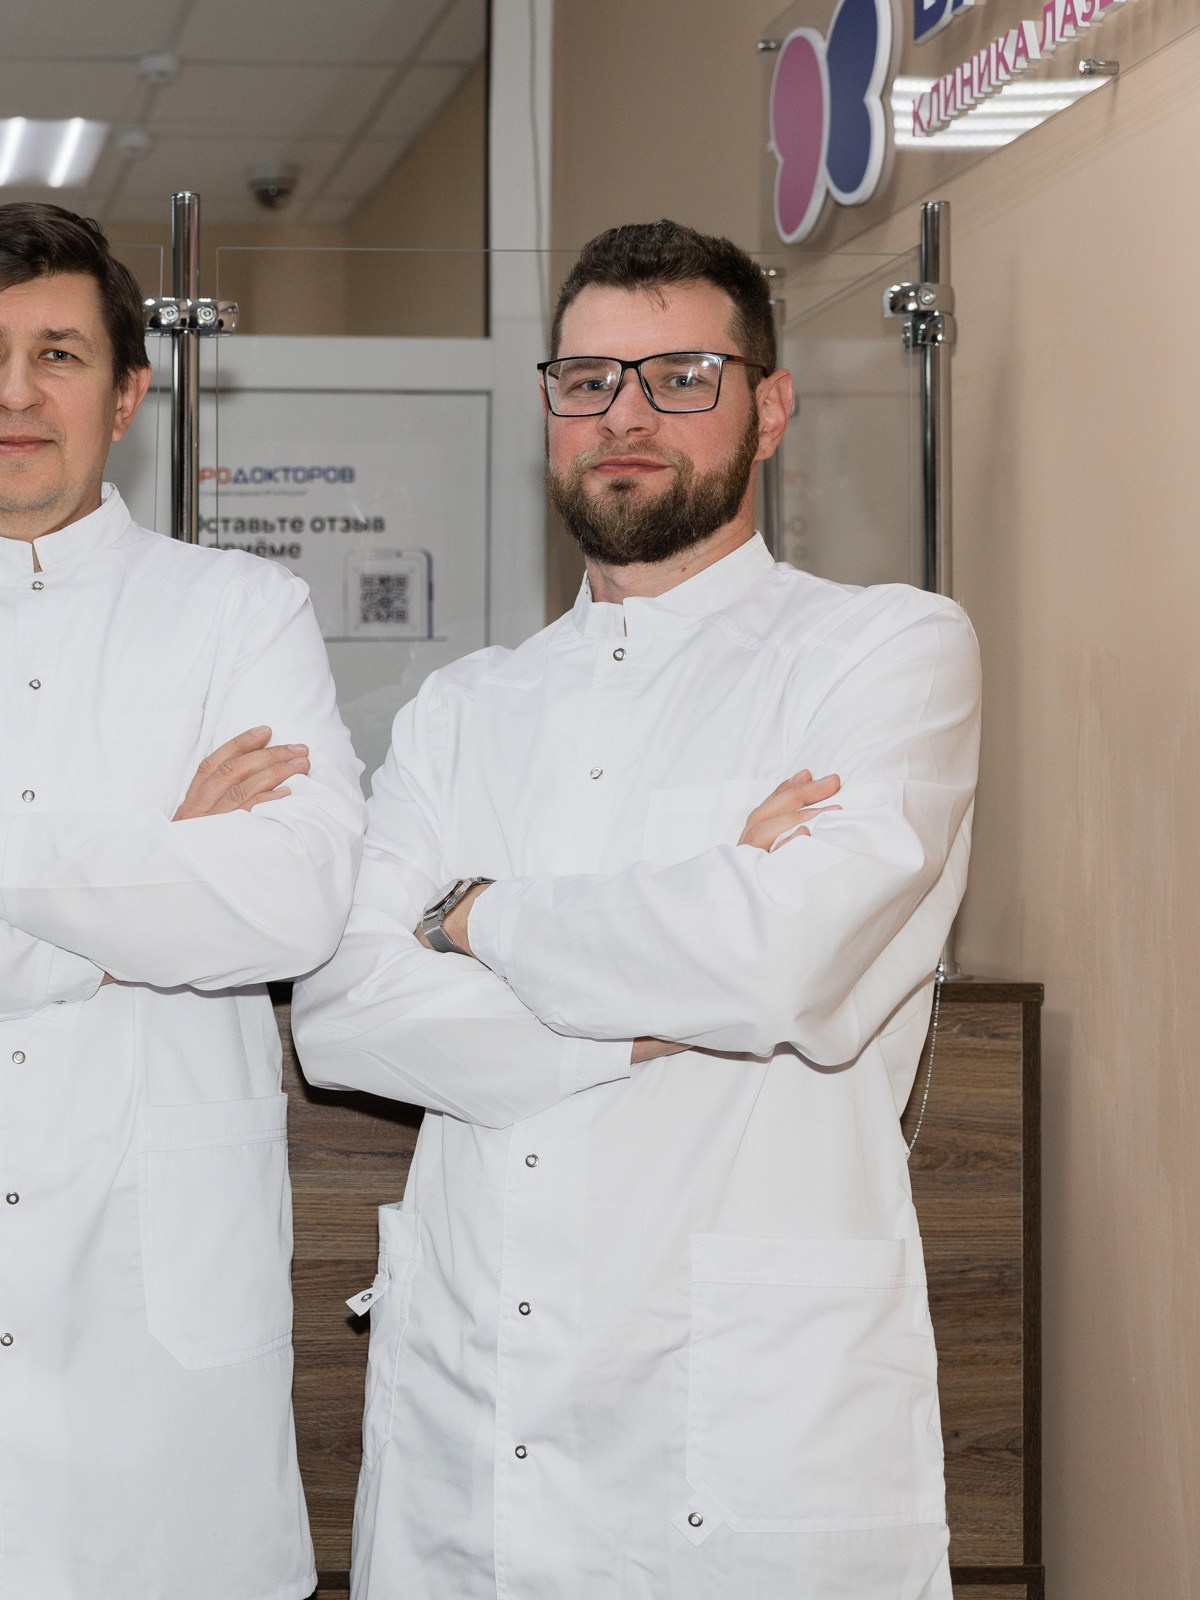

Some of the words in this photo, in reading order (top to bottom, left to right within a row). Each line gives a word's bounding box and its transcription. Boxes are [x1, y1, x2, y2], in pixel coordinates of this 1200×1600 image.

[912, 20, 1041, 137] КЛИНИКА
[1039, 0, 1116, 51] ЛАЗ
[198, 466, 357, 484] РОДОКТОРОВ
[310, 515, 387, 534] отзыв
